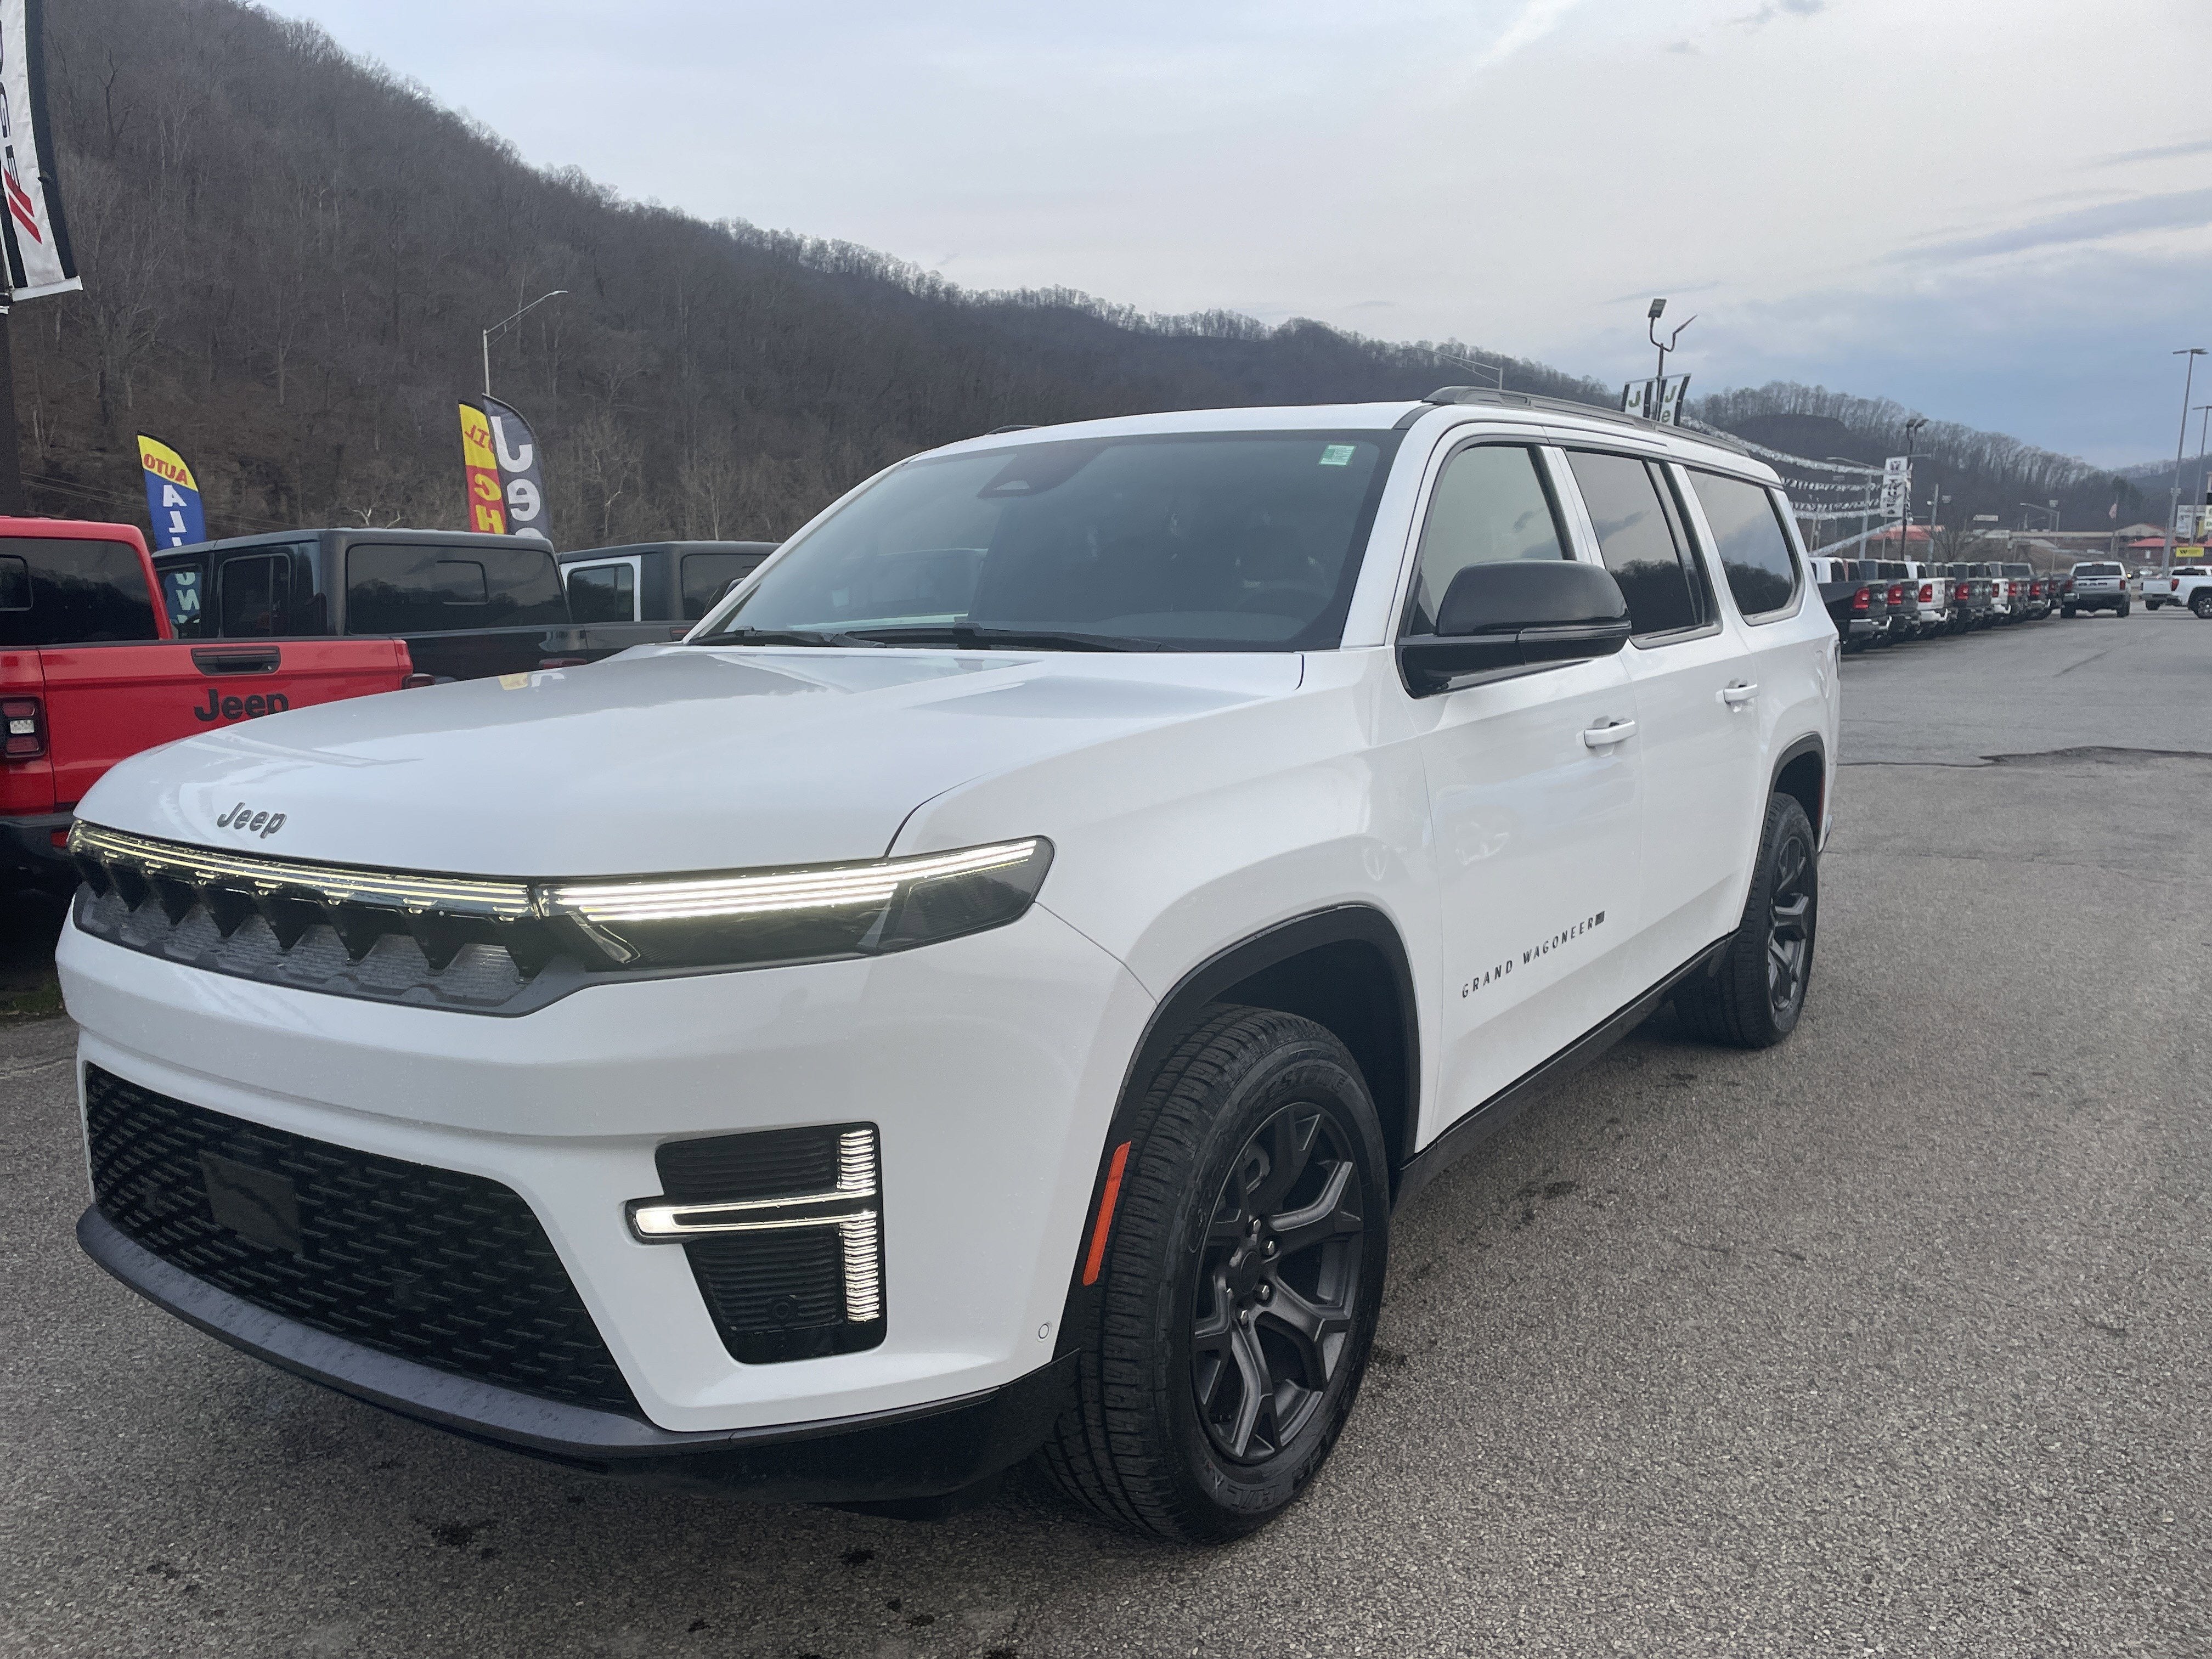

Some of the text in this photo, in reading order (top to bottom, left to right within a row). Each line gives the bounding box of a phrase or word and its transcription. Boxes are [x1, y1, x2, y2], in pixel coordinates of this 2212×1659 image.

[217, 802, 287, 839] Jeep
[1462, 917, 1594, 998] GRAND WAGONEER
